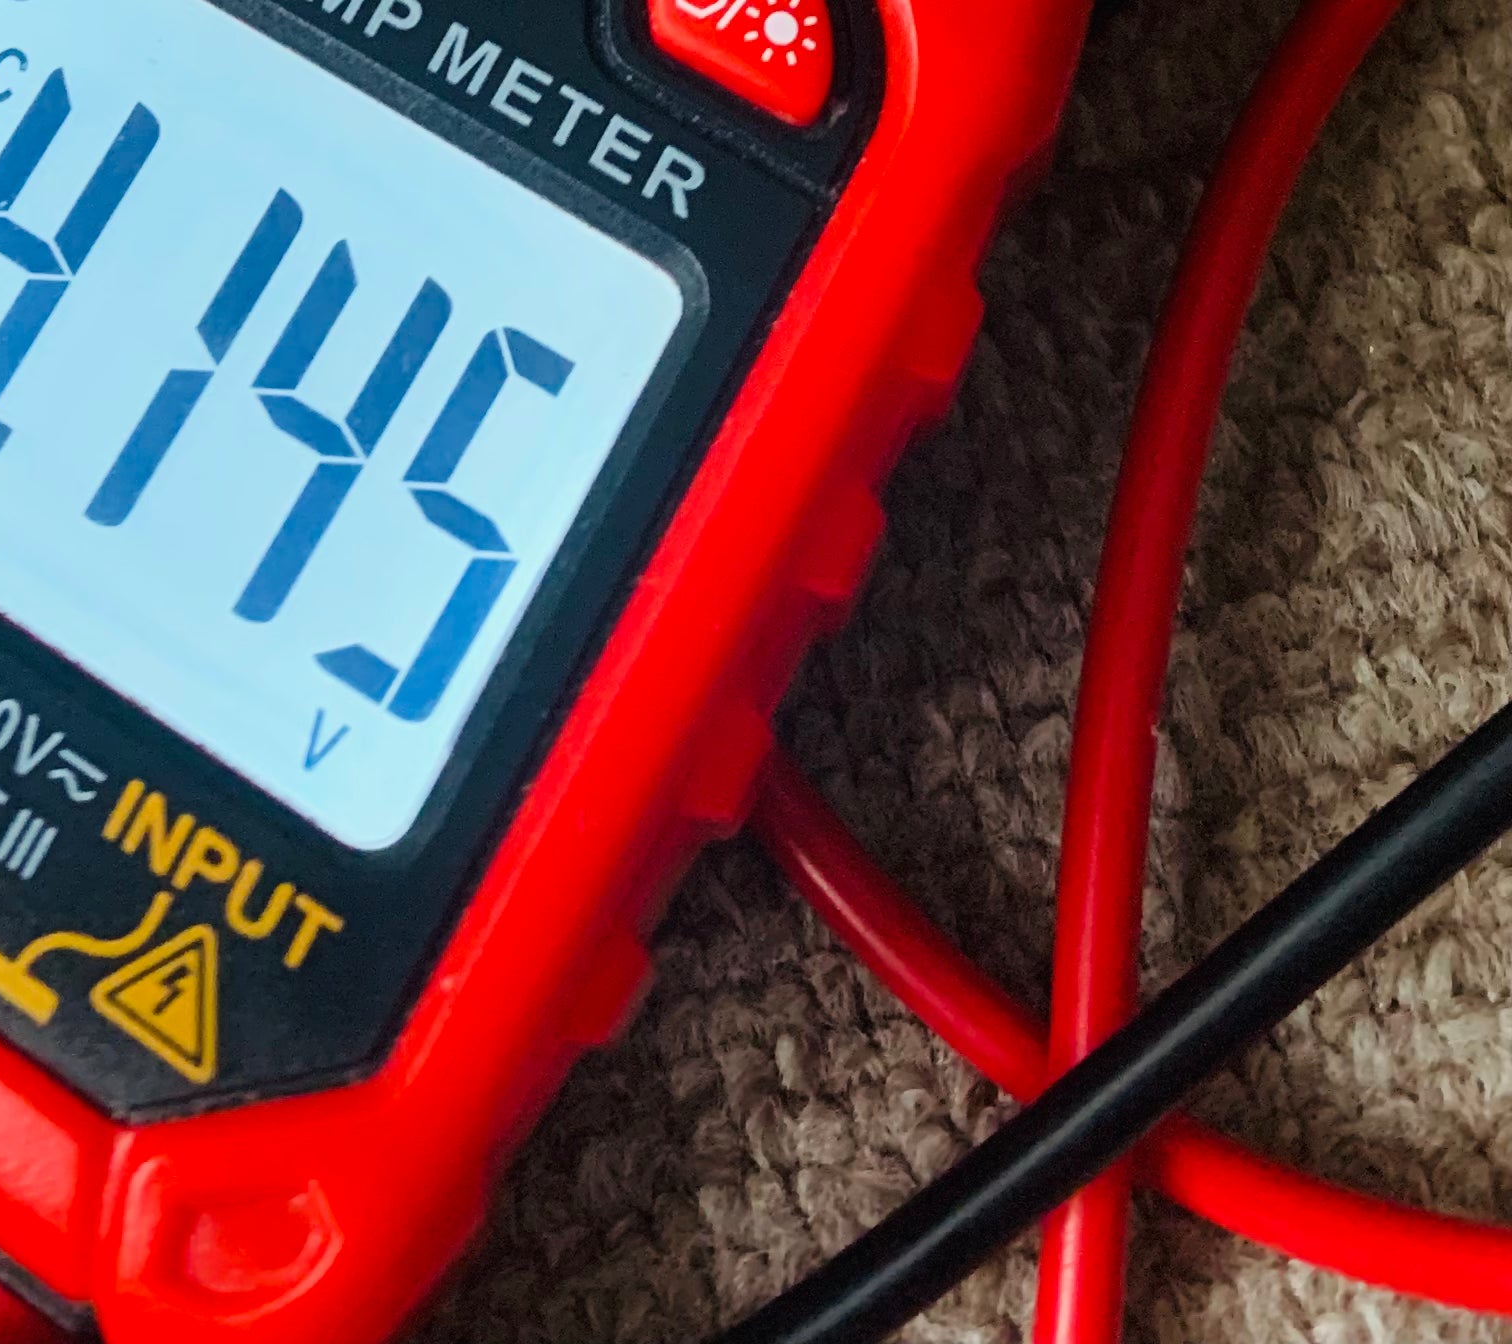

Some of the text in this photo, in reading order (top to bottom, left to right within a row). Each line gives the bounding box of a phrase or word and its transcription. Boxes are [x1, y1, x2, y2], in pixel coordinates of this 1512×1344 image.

[427, 21, 705, 220] METER
[304, 708, 351, 771] V
[102, 779, 345, 969] INPUT
